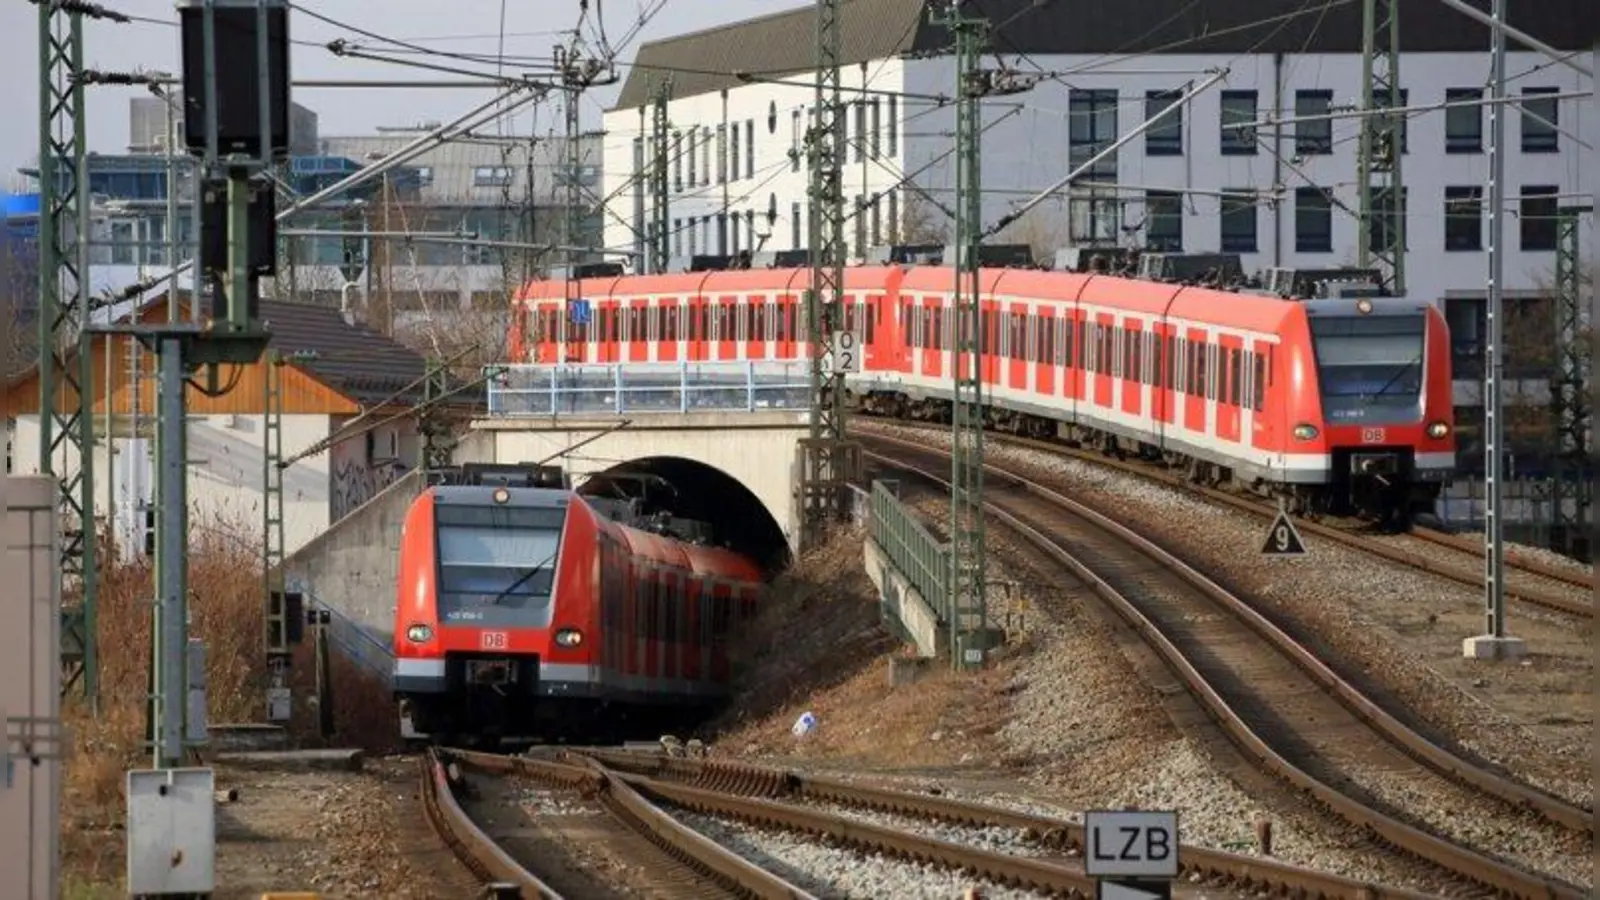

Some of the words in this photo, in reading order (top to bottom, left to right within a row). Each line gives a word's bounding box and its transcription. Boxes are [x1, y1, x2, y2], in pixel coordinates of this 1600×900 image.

[841, 352, 852, 369] 2
[1363, 429, 1384, 442] DB
[1276, 526, 1289, 551] 9
[482, 632, 506, 648] DB
[1093, 826, 1170, 860] LZB
